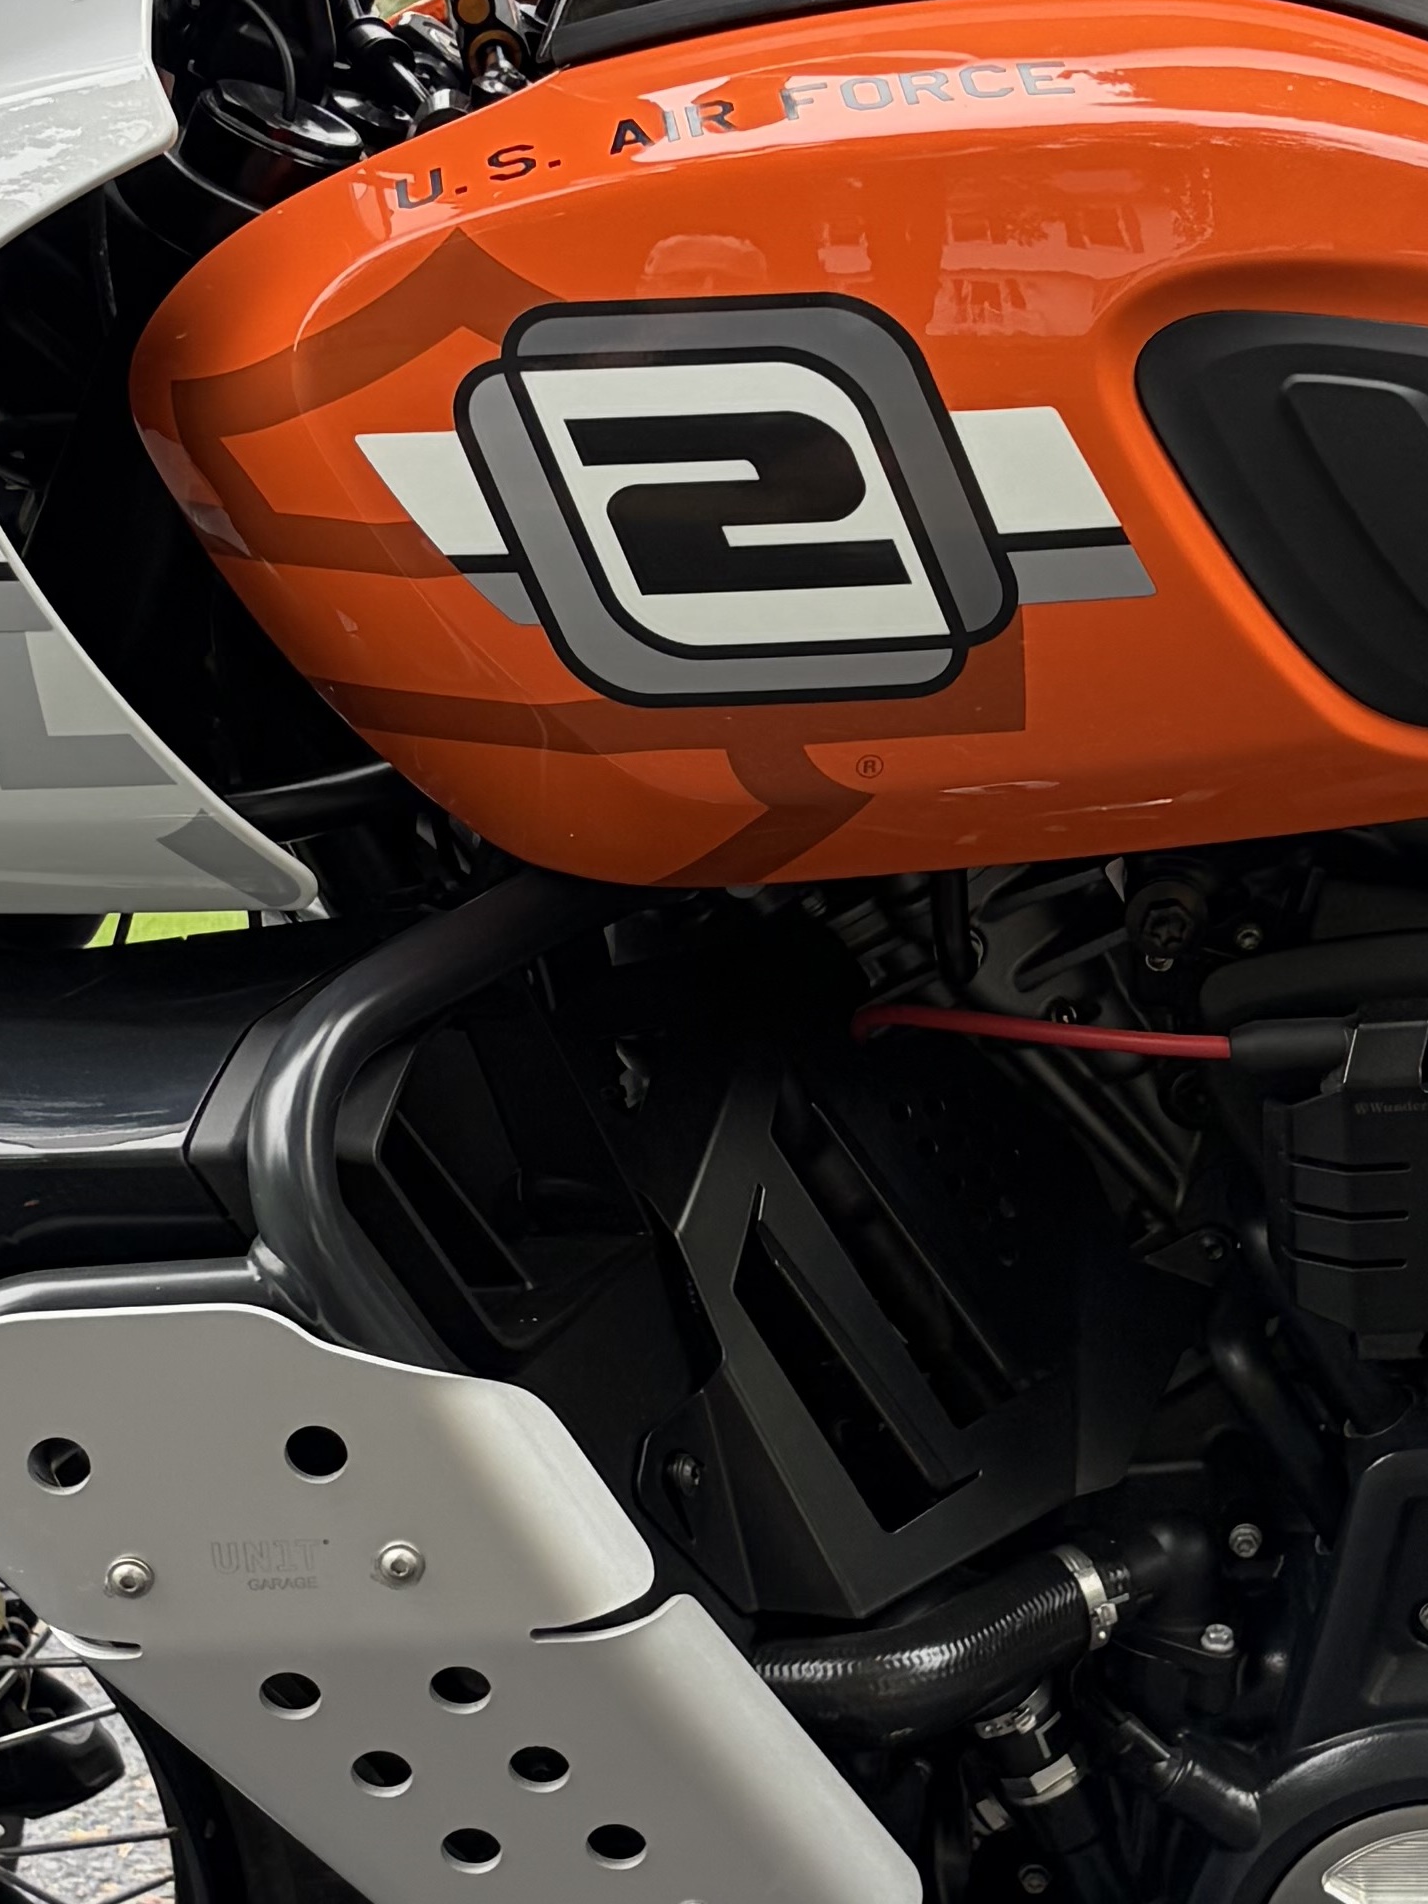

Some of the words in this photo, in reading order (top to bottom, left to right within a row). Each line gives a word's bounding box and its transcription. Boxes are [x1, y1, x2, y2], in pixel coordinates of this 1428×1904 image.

[609, 99, 739, 155] AIR
[781, 60, 1076, 121] FORCE
[562, 409, 912, 597] 2
[210, 1538, 321, 1575] UNIT
[247, 1575, 320, 1591] GARAGE
